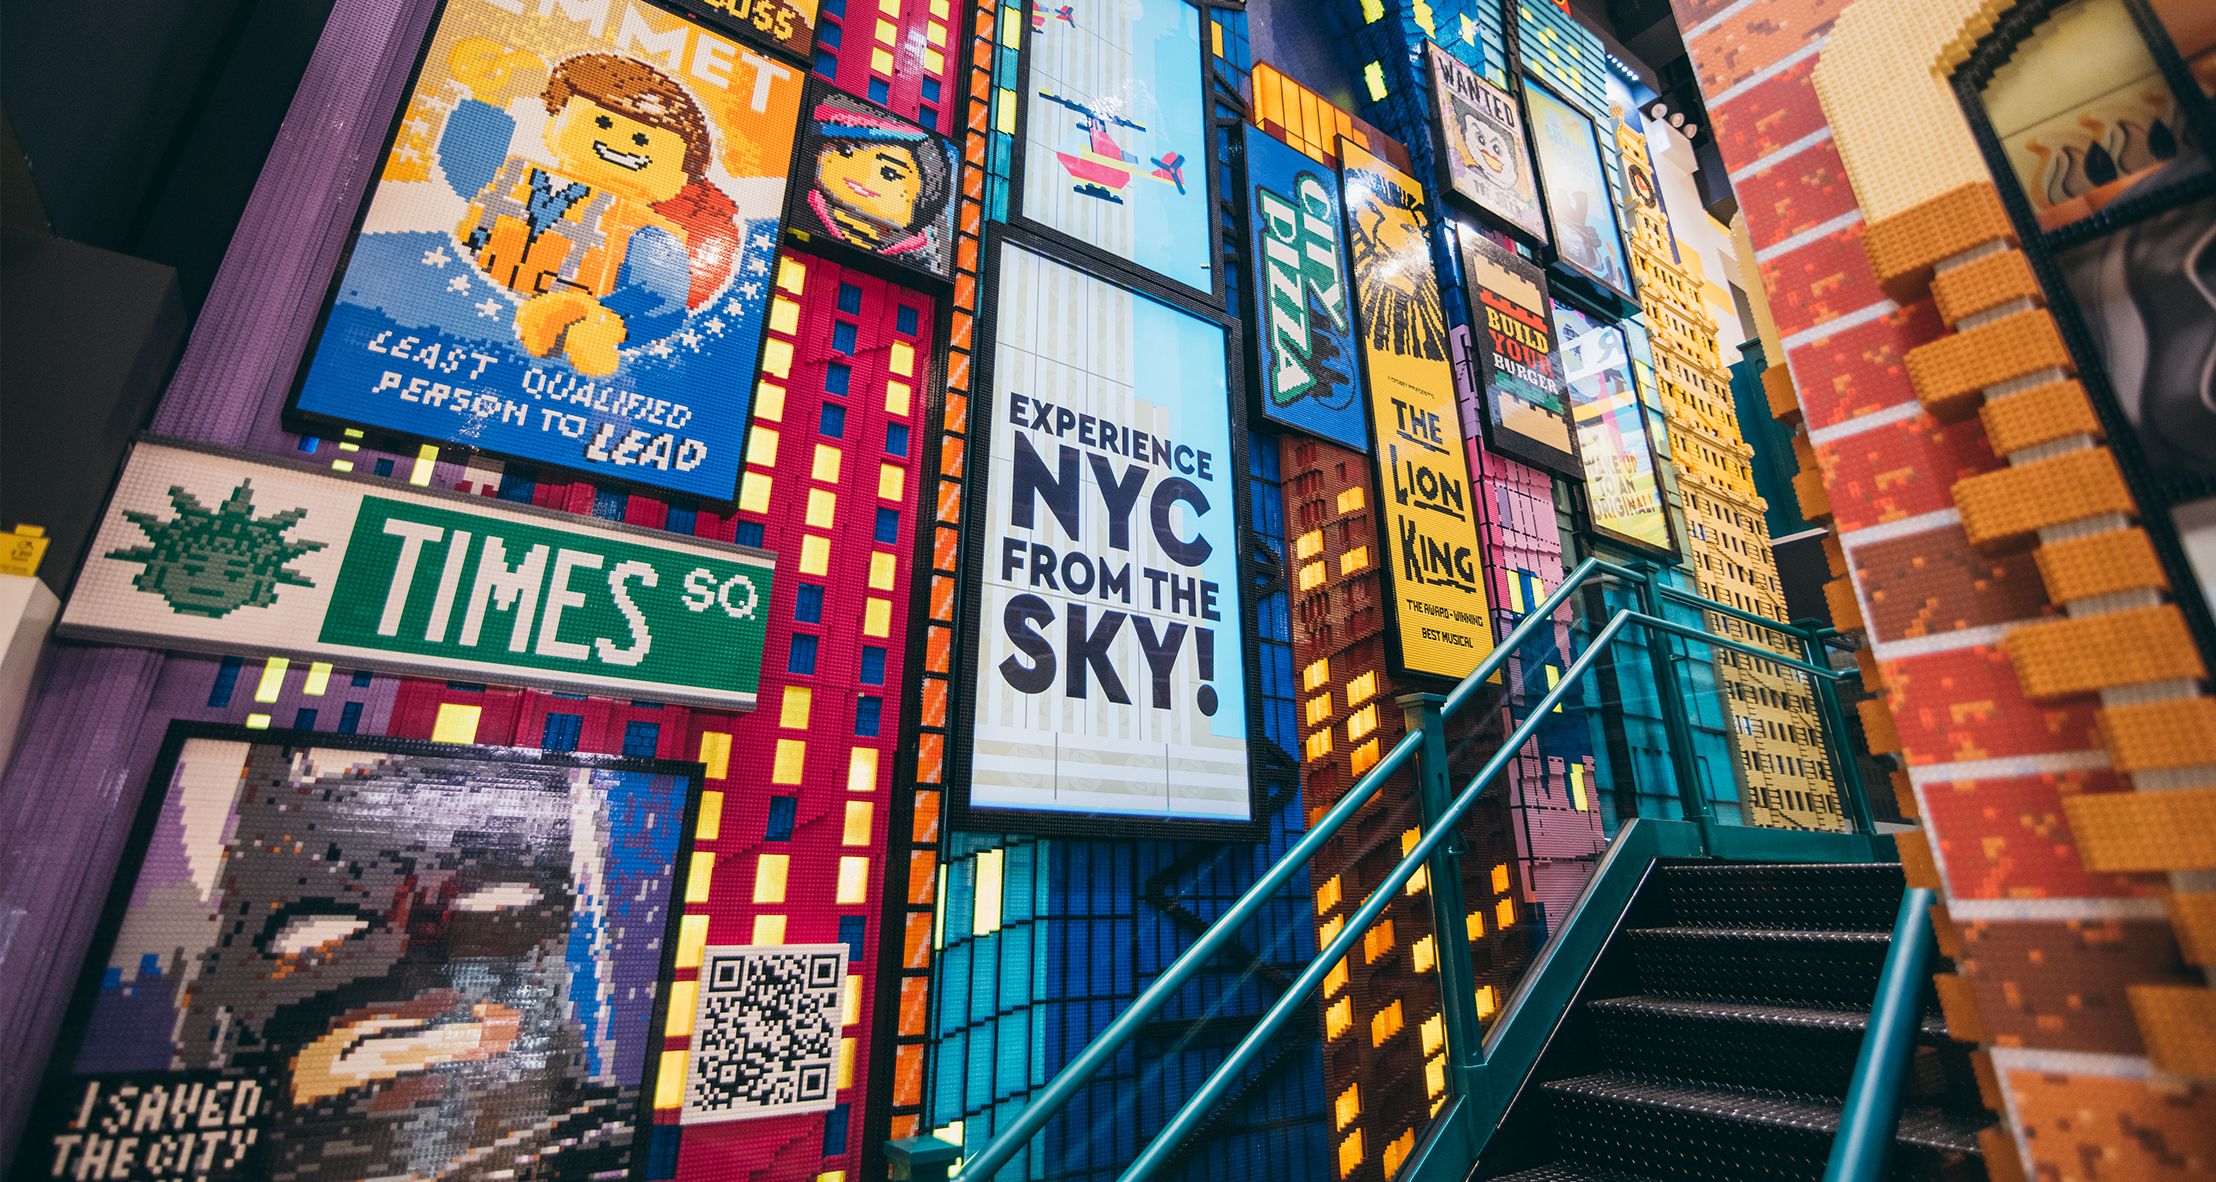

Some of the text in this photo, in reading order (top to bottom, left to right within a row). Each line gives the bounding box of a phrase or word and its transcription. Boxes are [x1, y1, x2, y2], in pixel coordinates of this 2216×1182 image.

[703, 0, 796, 41] OSS
[484, 0, 793, 114] MMET
[1438, 56, 1515, 128] WANTED
[1298, 177, 1346, 329] CITY
[1262, 195, 1311, 394] PIZZA
[1484, 305, 1549, 354] BUILD
[367, 330, 693, 430] LEAST QUALIFIED
[1488, 328, 1553, 378] YOUR
[1492, 352, 1559, 395] BURGER
[371, 370, 708, 472] PERSON TO LEAD
[1009, 391, 1214, 482] EXPERIENCE
[1390, 396, 1444, 446] THE
[1010, 429, 1214, 568] NYC
[1389, 443, 1465, 512] LION
[1618, 474, 1637, 496] AN
[1001, 536, 1221, 622] FROM THE
[1398, 514, 1476, 585] KING
[377, 518, 760, 667] TIMES SQ
[1406, 599, 1424, 613] THE
[998, 592, 1219, 717] SKY!
[1421, 627, 1474, 649] BEST MUSICAL
[76, 1079, 262, 1134] I SAVED
[51, 1128, 258, 1182] THE CITY
